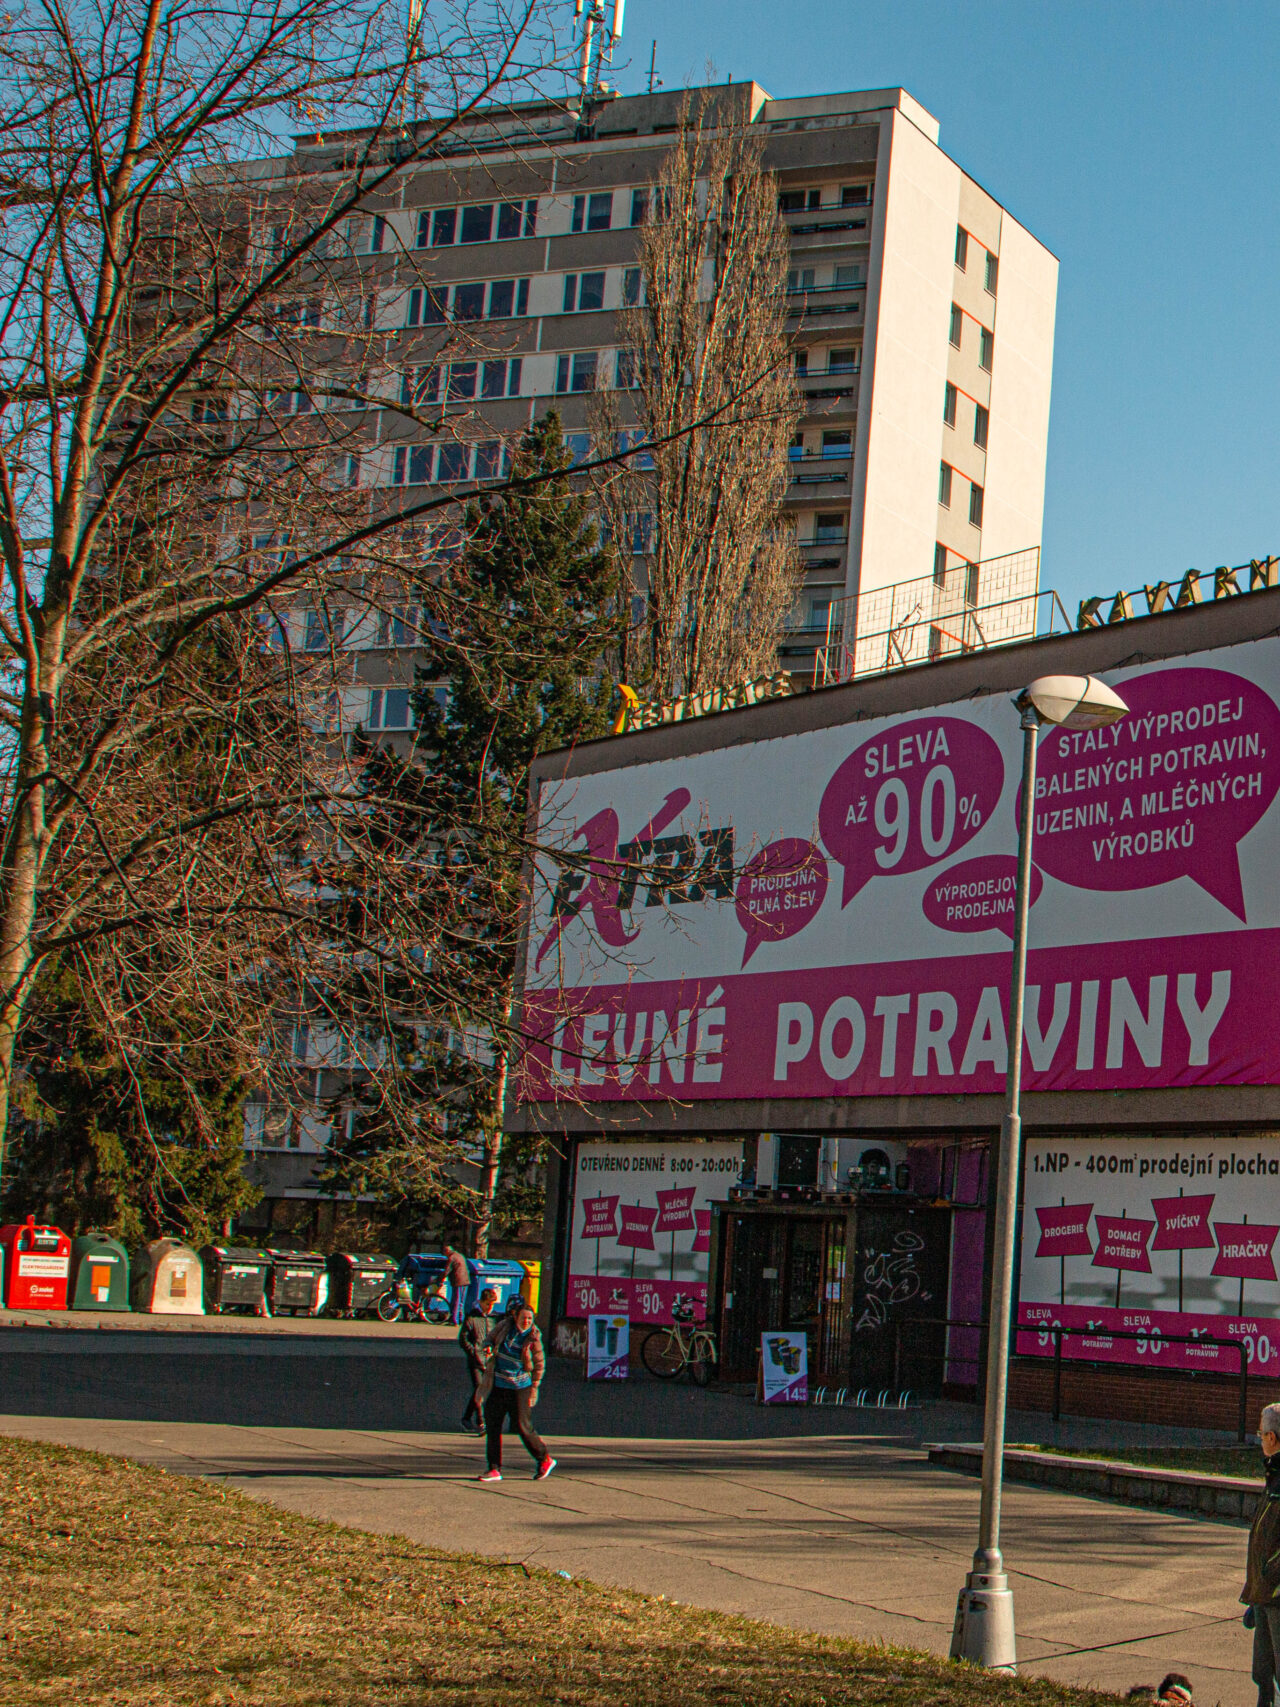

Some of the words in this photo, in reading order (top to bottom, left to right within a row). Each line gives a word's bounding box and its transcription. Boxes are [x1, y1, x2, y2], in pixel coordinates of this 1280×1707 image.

[1129, 697, 1244, 742] VÝPRODEJ
[864, 726, 950, 779] SLEVA
[1035, 754, 1143, 799] BALENÝCH
[1149, 732, 1267, 775] POTRAVIN,
[844, 795, 868, 827] AŽ
[1035, 800, 1115, 836] UZENIN,
[1119, 802, 1134, 820] A
[1141, 771, 1263, 817] MLÉČNÝCH
[1092, 818, 1195, 862] VÝROBKŮ
[749, 868, 817, 892] PRODEJNA
[935, 876, 1018, 903] VÝPRODEJOV
[748, 894, 781, 915] PLNÁ
[784, 889, 816, 911] SLEV
[946, 897, 1015, 921] PRODEJNA
[551, 984, 727, 1086] LEVNÉ
[773, 969, 1232, 1082] POTRAVINY
[580, 1154, 630, 1172] OTEVŘENO
[670, 1158, 694, 1173] 8:00
[702, 1156, 740, 1173] 20:00h
[1033, 1153, 1069, 1173] 1.NP
[1139, 1153, 1214, 1178] prodejní
[1218, 1152, 1280, 1179] plocha
[626, 1223, 649, 1233] UZENINY
[1044, 1223, 1084, 1239] DROGERIE
[1165, 1214, 1201, 1230] SVÍČKY
[1104, 1242, 1142, 1259] POTŘEBY
[1222, 1240, 1268, 1258] HRAČKY
[573, 1280, 591, 1289] SLEVA
[635, 1283, 653, 1293] SLEVA
[1026, 1309, 1052, 1319] SLEVA
[1123, 1315, 1151, 1326] SLEVA
[1228, 1323, 1258, 1334] SLEVA
[1185, 1348, 1219, 1358] POTRAVINY
[783, 1386, 800, 1400] 14
